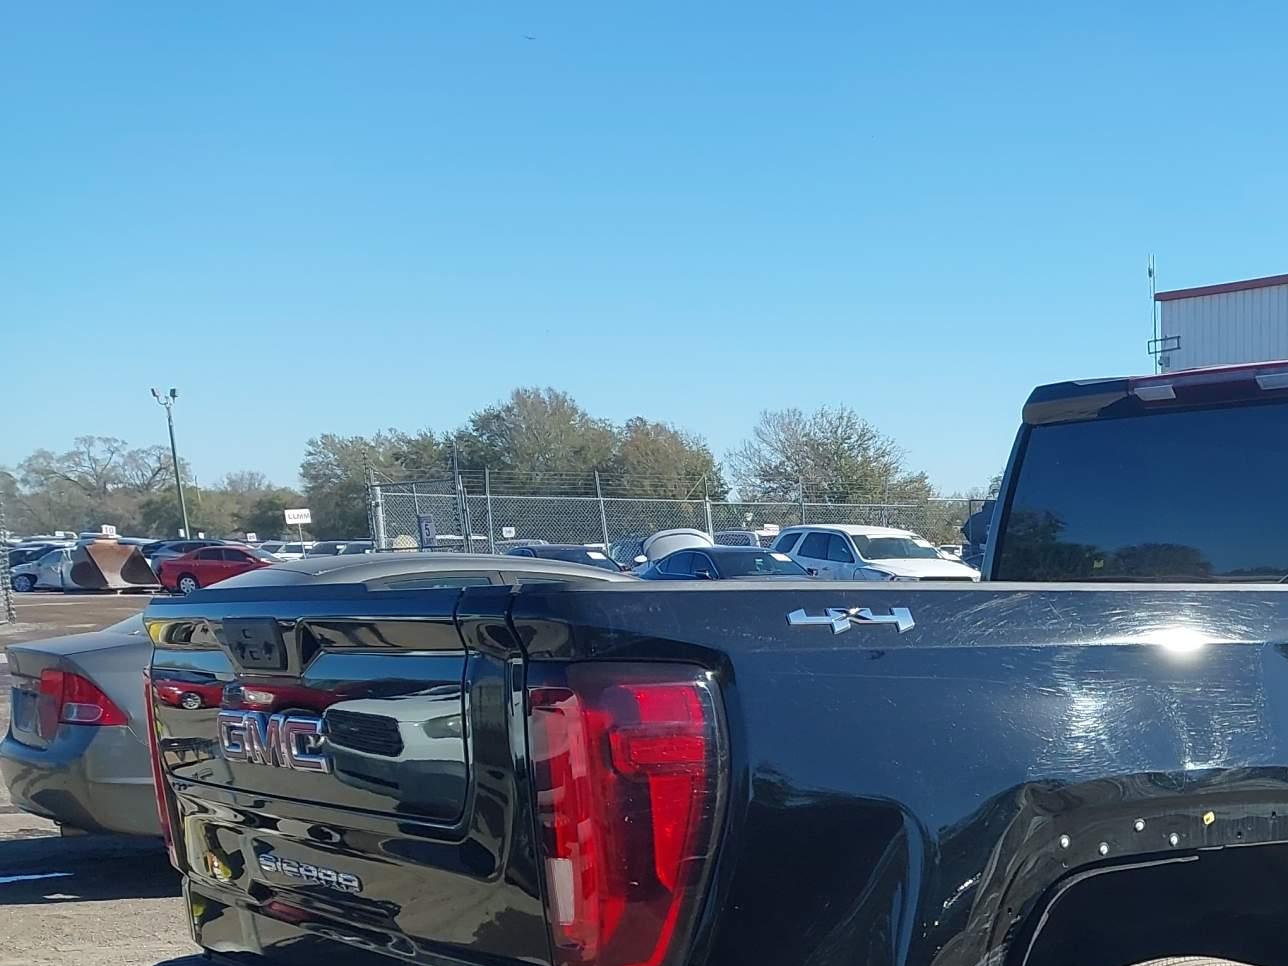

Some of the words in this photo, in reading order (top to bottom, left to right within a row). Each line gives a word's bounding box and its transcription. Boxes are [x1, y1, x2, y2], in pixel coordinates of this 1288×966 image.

[424, 523, 431, 537] 5
[217, 710, 329, 774] GMC
[259, 853, 362, 893] SIERRA
